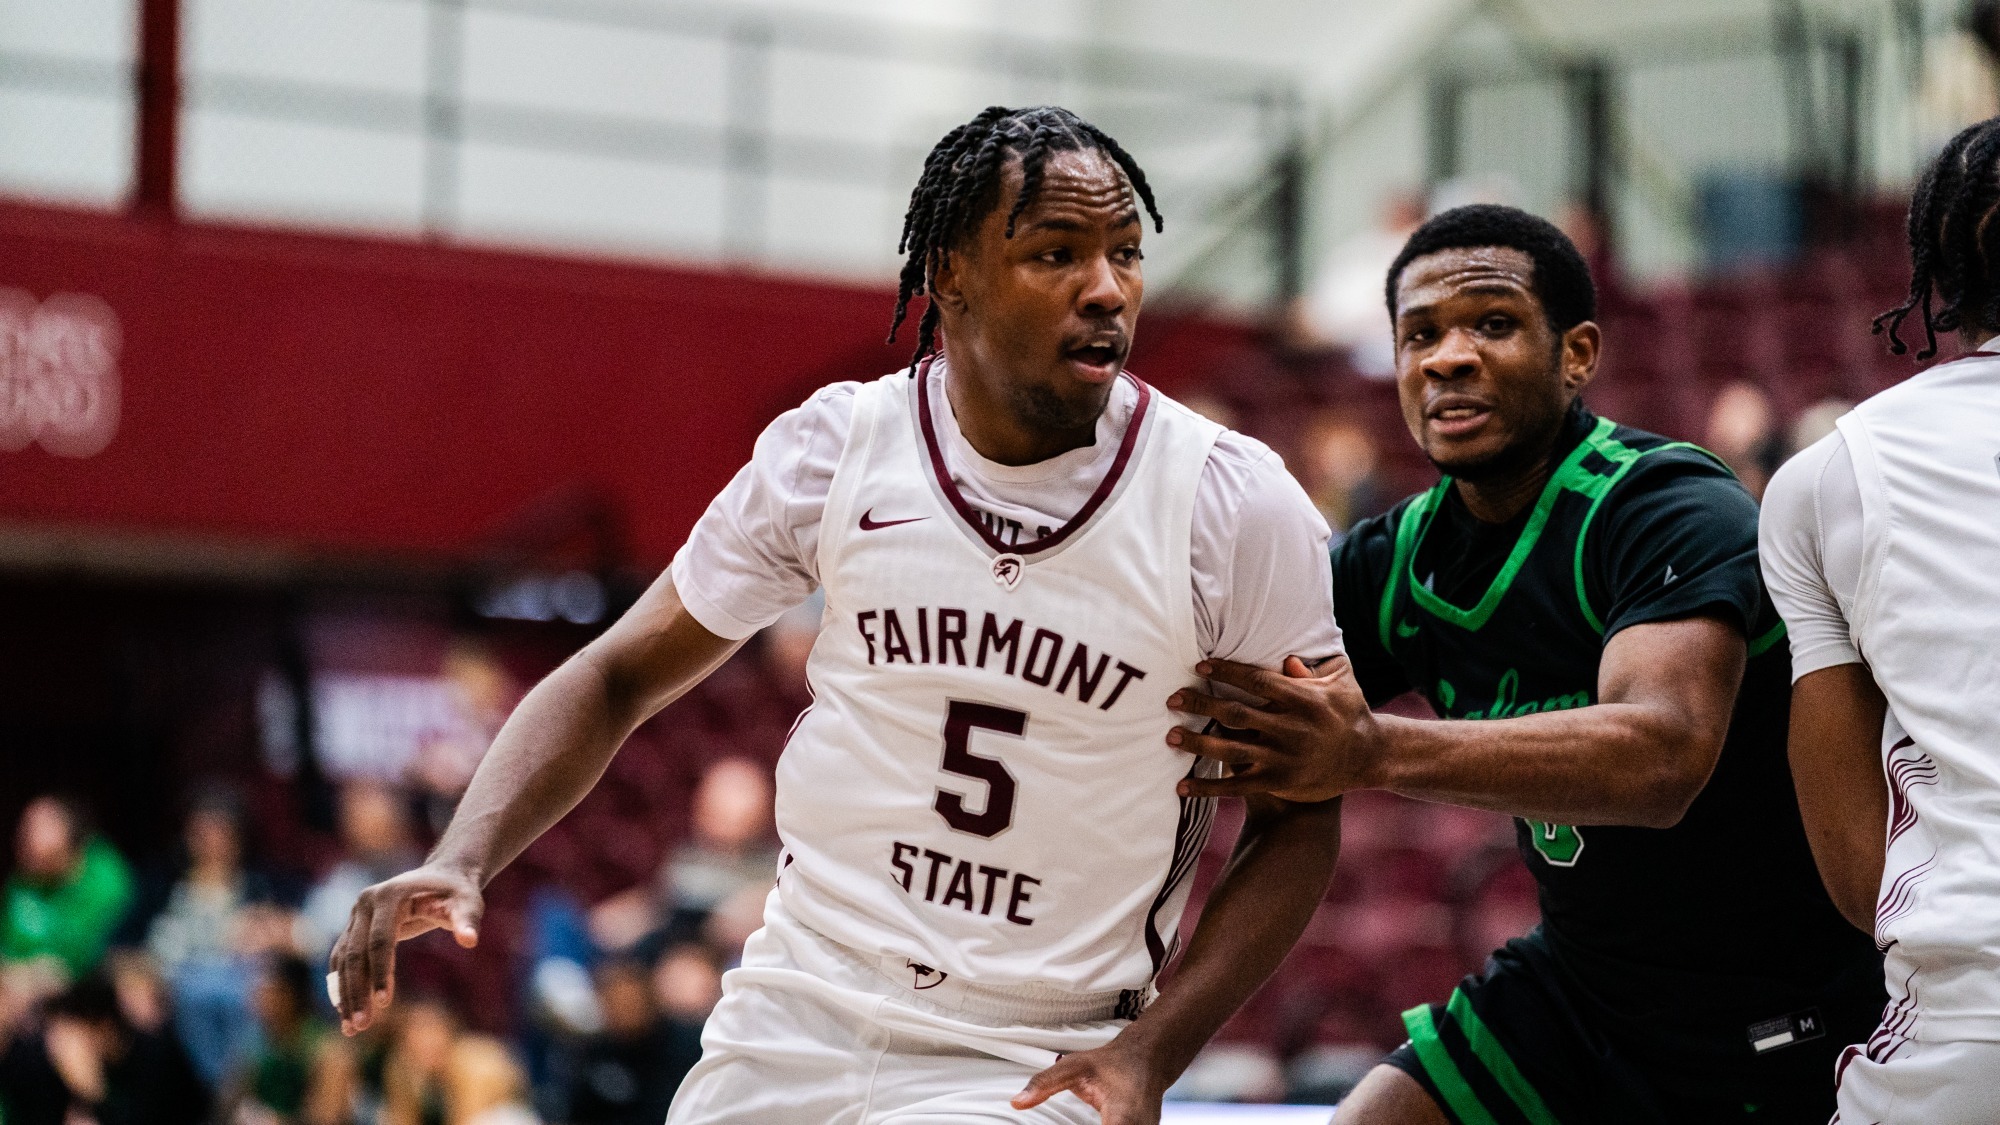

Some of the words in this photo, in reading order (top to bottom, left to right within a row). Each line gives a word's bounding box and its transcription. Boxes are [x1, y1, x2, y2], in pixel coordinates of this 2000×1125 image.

[857, 607, 1147, 711] FAIRMONT
[931, 696, 1031, 841] 5
[889, 841, 1042, 926] STATE
[1799, 1016, 1816, 1033] M
